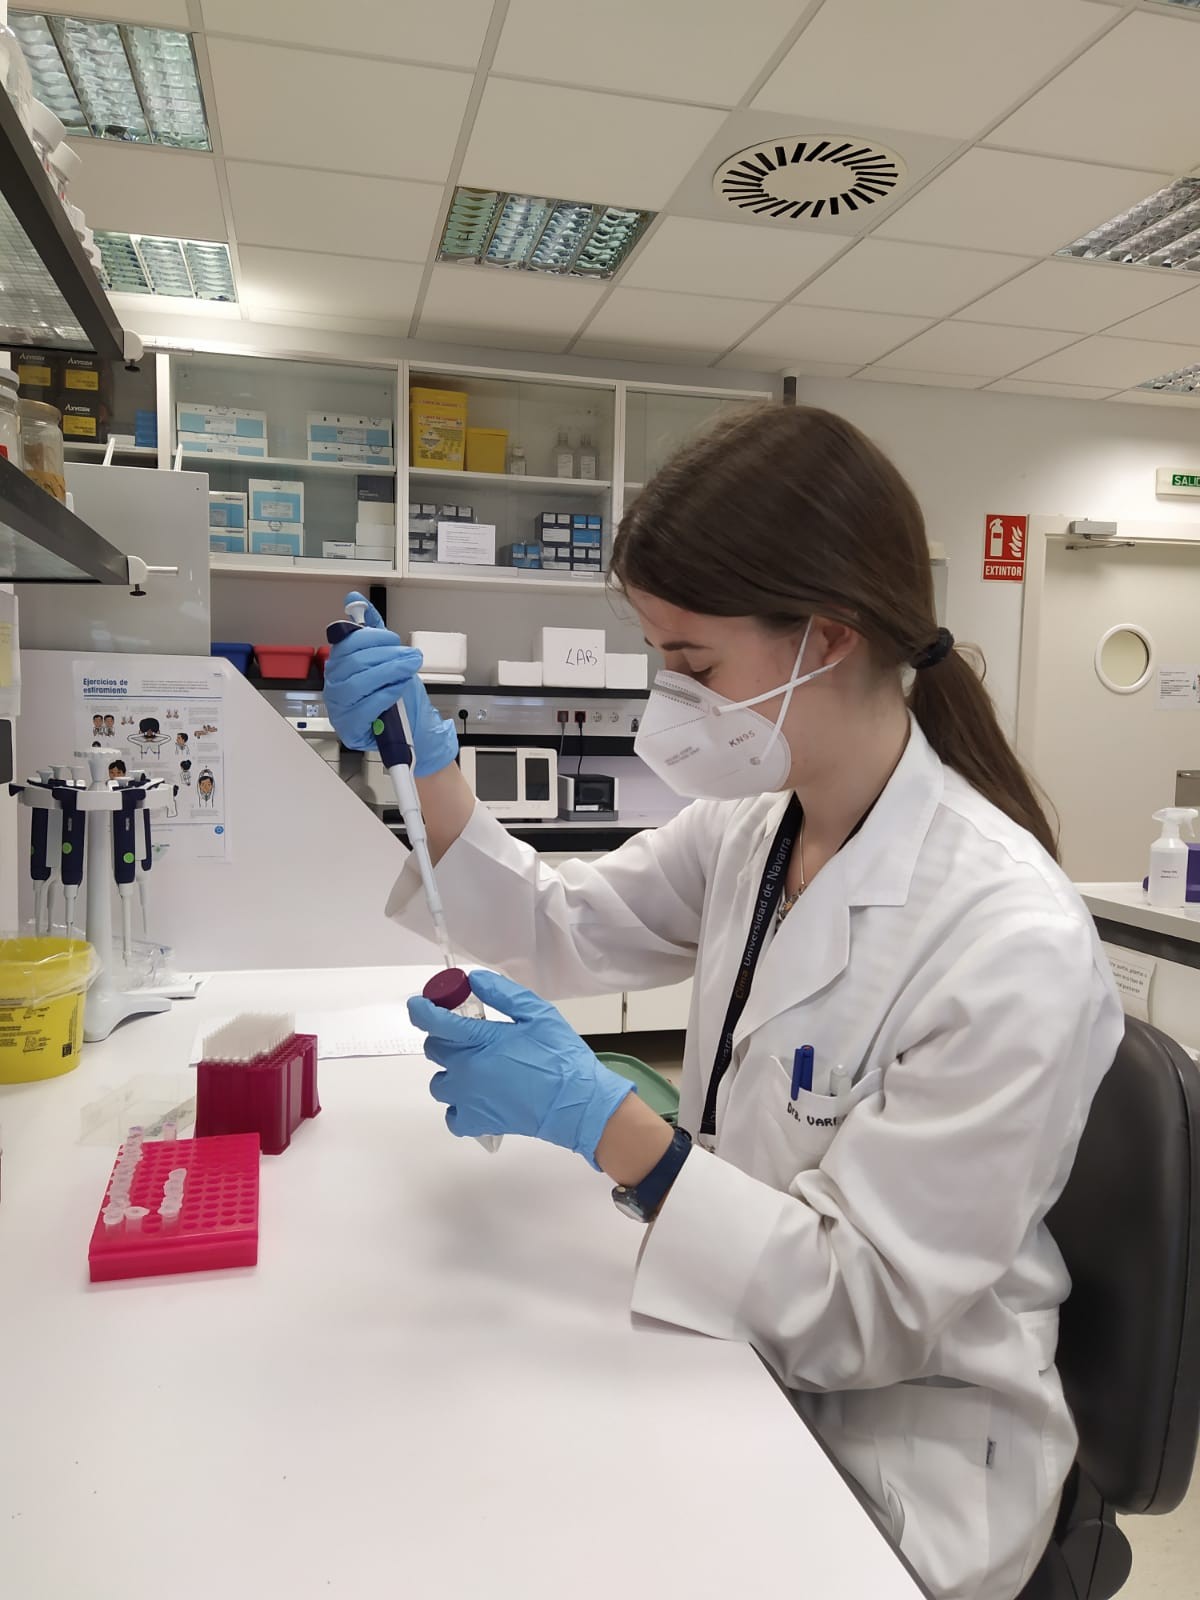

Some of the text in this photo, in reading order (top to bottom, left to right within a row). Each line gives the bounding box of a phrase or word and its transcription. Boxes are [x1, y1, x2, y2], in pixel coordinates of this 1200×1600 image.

[985, 565, 1022, 577] EXTINTOR
[565, 648, 598, 666] LAB
[82, 678, 117, 687] Ejercicios
[83, 686, 128, 694] estiramiento
[728, 730, 756, 748] KN95
[767, 836, 792, 881] Navarra
[763, 883, 775, 898] de
[743, 901, 768, 967] Universidad
